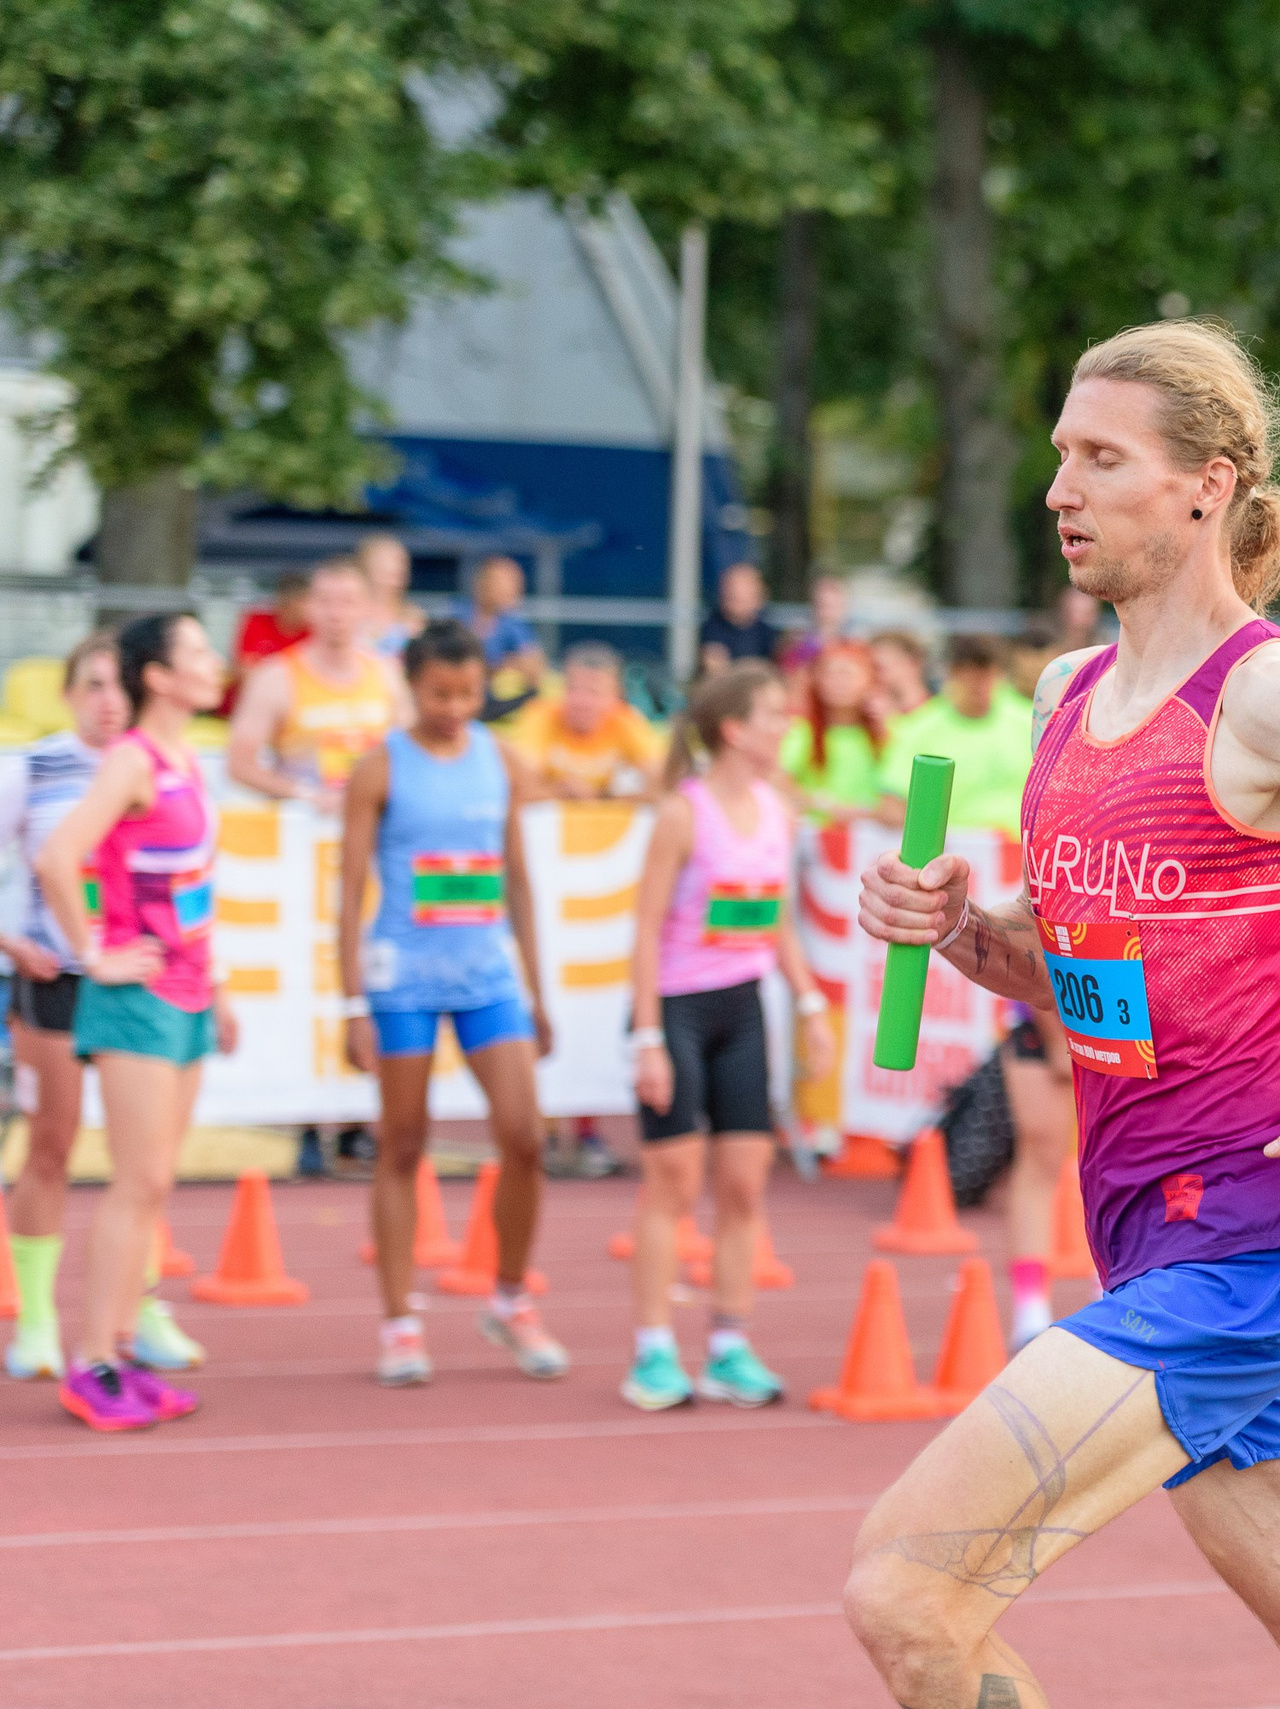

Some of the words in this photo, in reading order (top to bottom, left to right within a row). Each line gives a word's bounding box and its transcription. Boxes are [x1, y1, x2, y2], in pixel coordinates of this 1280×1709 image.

[1054, 968, 1103, 1024] 206
[1117, 999, 1131, 1026] 3
[1120, 1309, 1159, 1344] SAXX
